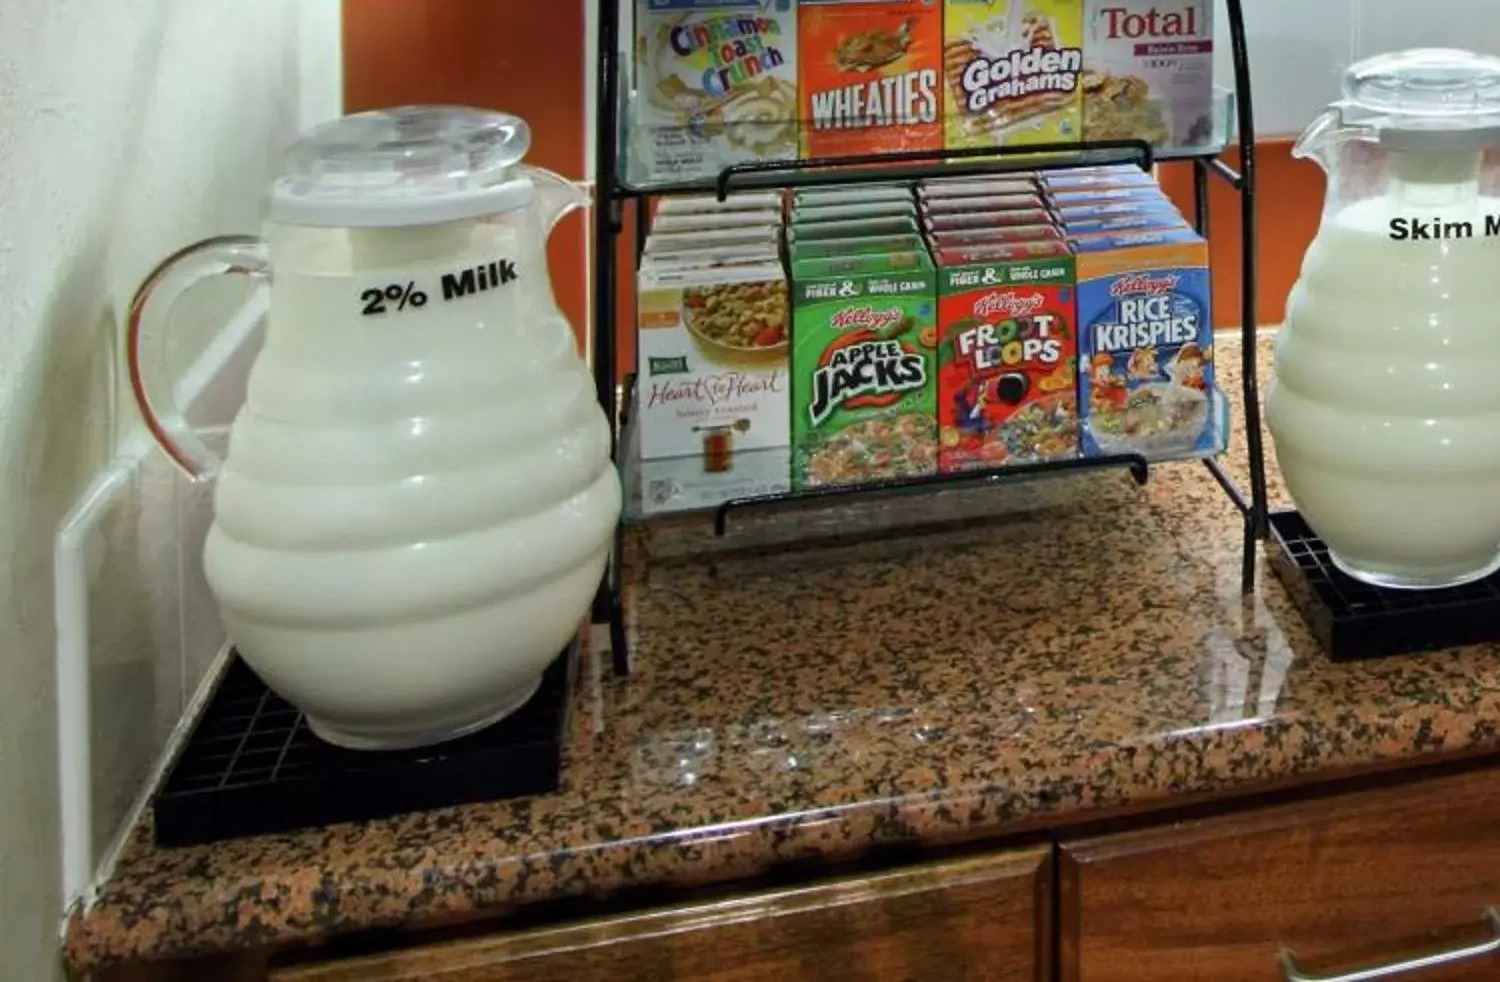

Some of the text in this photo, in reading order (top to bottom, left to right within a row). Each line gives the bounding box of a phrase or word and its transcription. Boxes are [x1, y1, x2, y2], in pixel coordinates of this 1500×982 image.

[1101, 5, 1197, 39] Total
[702, 46, 785, 98] Crunch
[963, 48, 1083, 92] Golden
[811, 68, 937, 130] WHEATIES
[969, 71, 1076, 111] Grahams
[1388, 216, 1473, 241] Skim
[360, 258, 518, 316] 2% Milk
[1120, 295, 1171, 324] RICE
[958, 315, 1054, 355] FROOT
[1095, 315, 1198, 352] KRISPIES
[831, 342, 899, 368] APPLE
[975, 338, 1063, 369] LOOPS
[649, 377, 703, 408] Heart
[722, 370, 784, 400] Heart
[811, 355, 924, 419] JACKS
